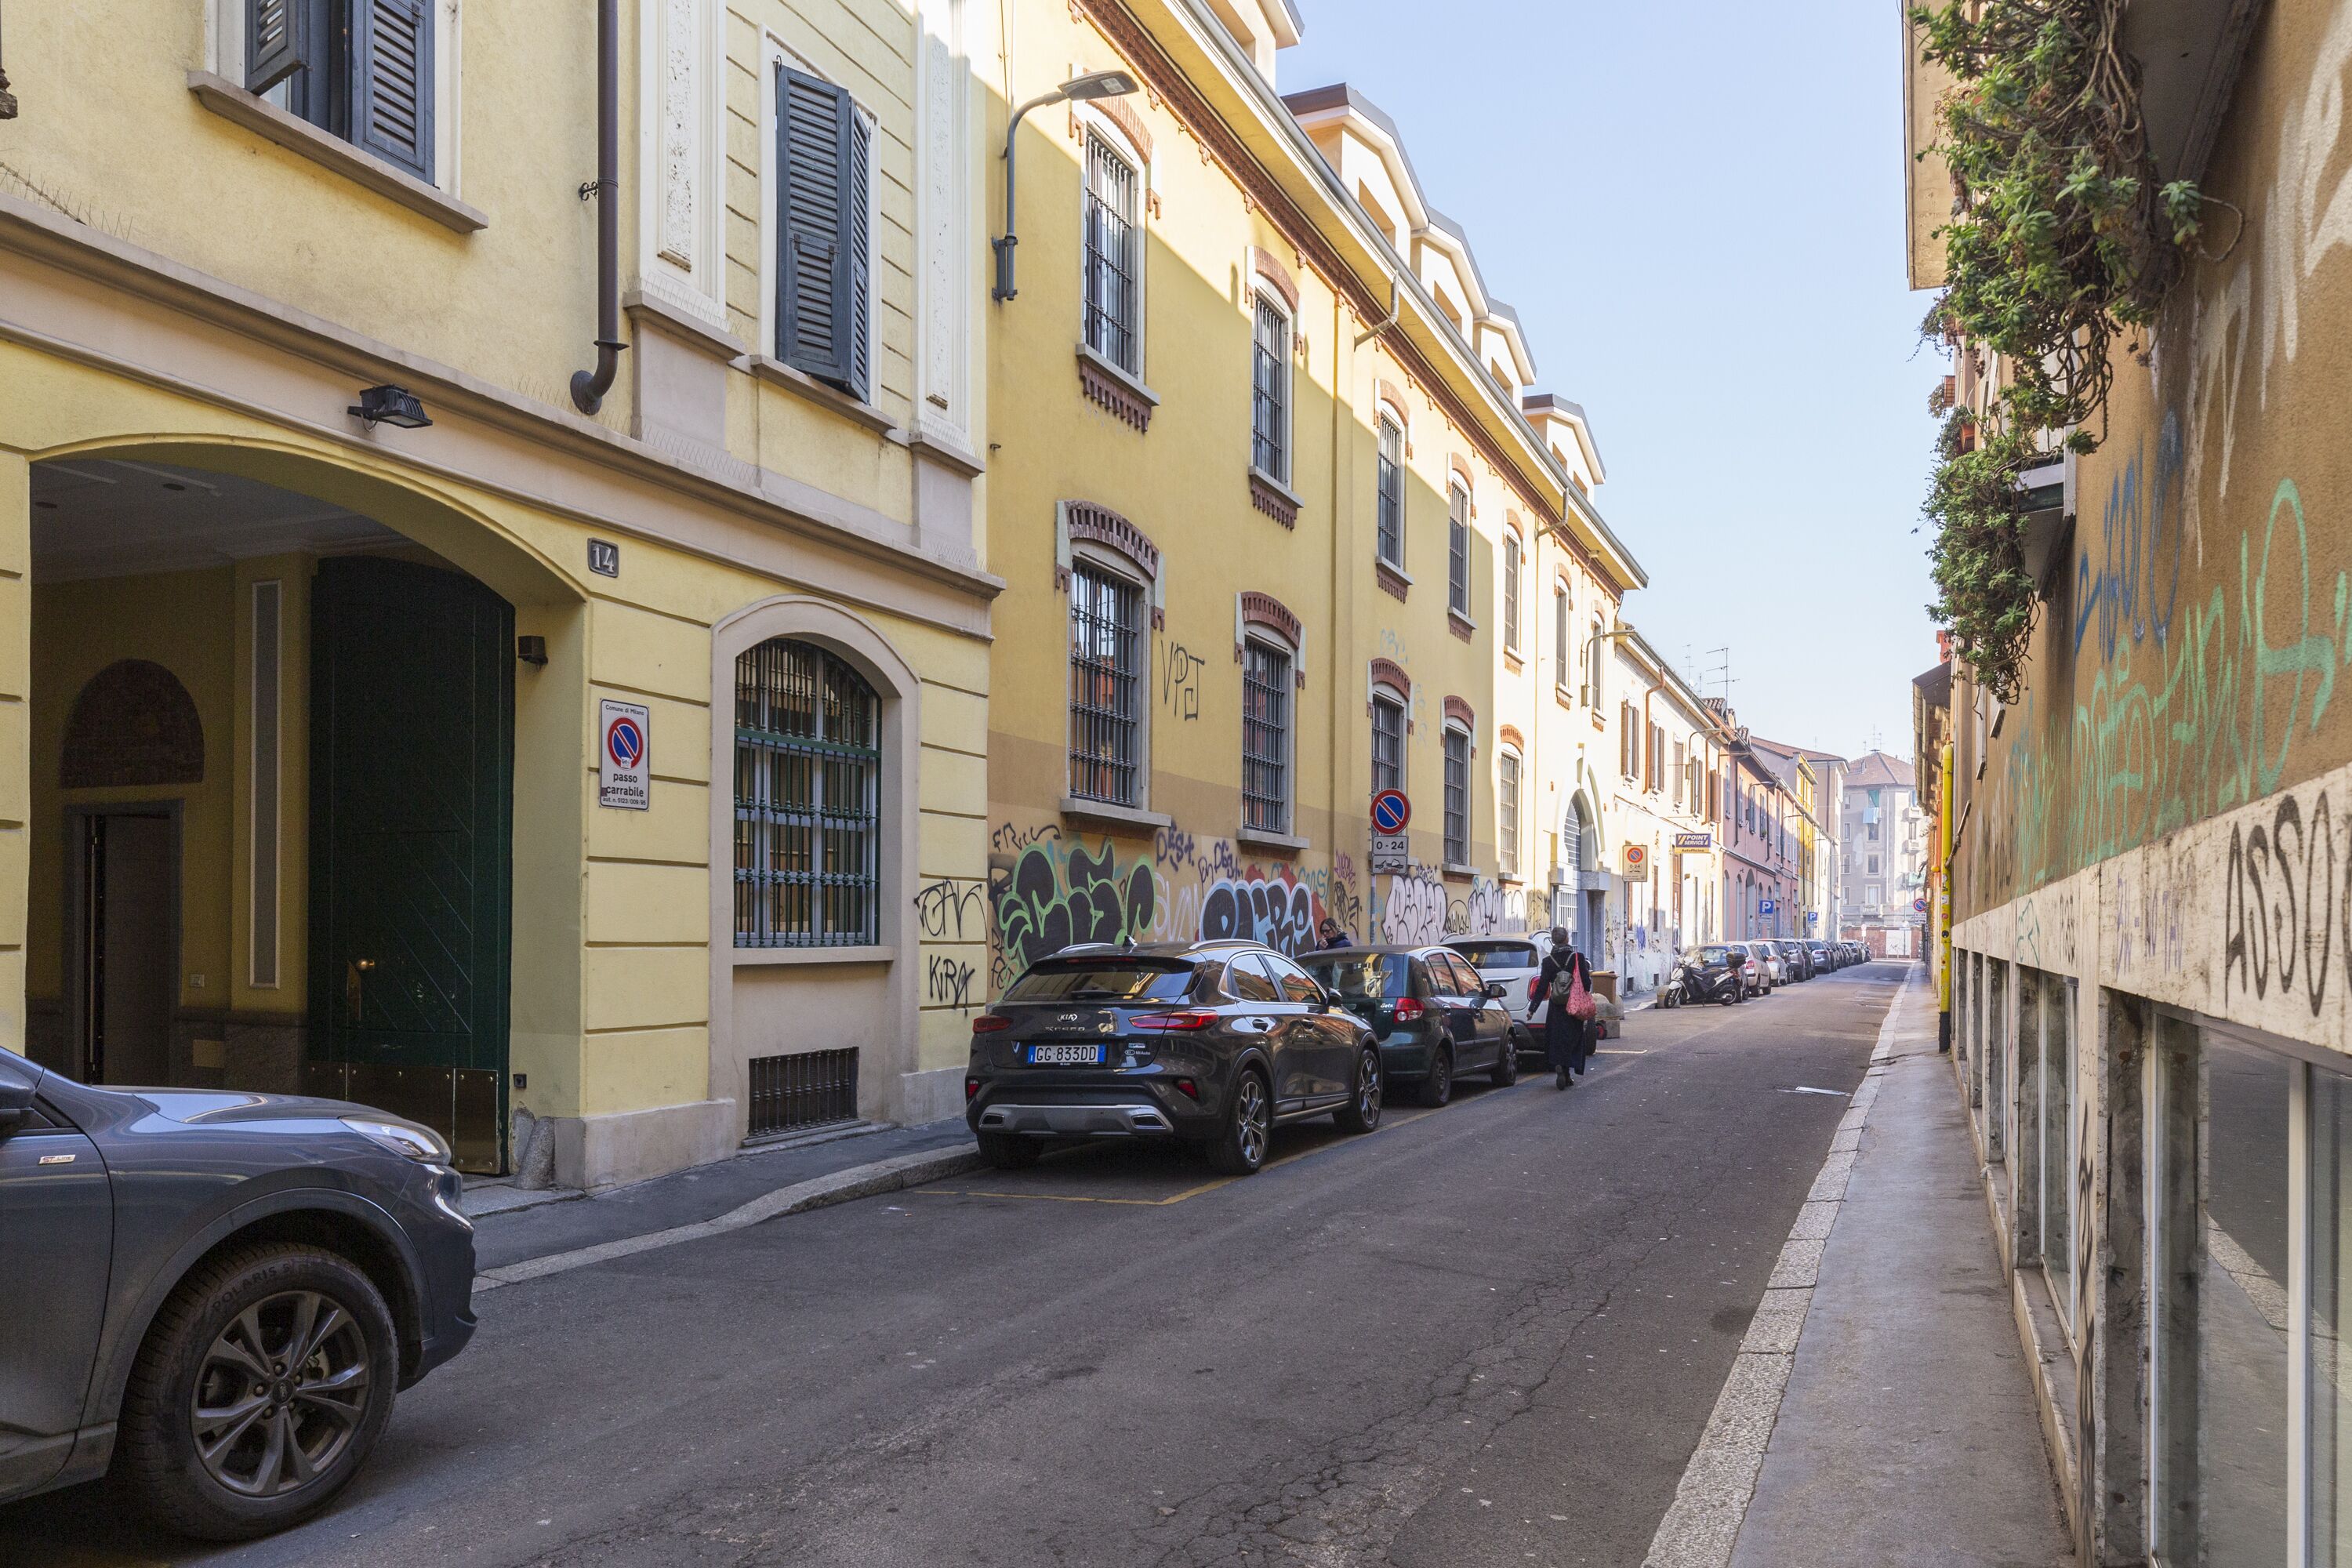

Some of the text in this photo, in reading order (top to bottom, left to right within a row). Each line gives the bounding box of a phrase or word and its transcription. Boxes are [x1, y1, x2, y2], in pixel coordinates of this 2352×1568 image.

[592, 544, 615, 573] 14
[605, 704, 623, 713] Comune
[613, 772, 638, 783] passo
[606, 786, 644, 797] carrabile
[1391, 841, 1404, 850] 24
[1762, 901, 1771, 913] P
[2225, 790, 2352, 1018] ASSO
[212, 1265, 278, 1310] POLARIS
